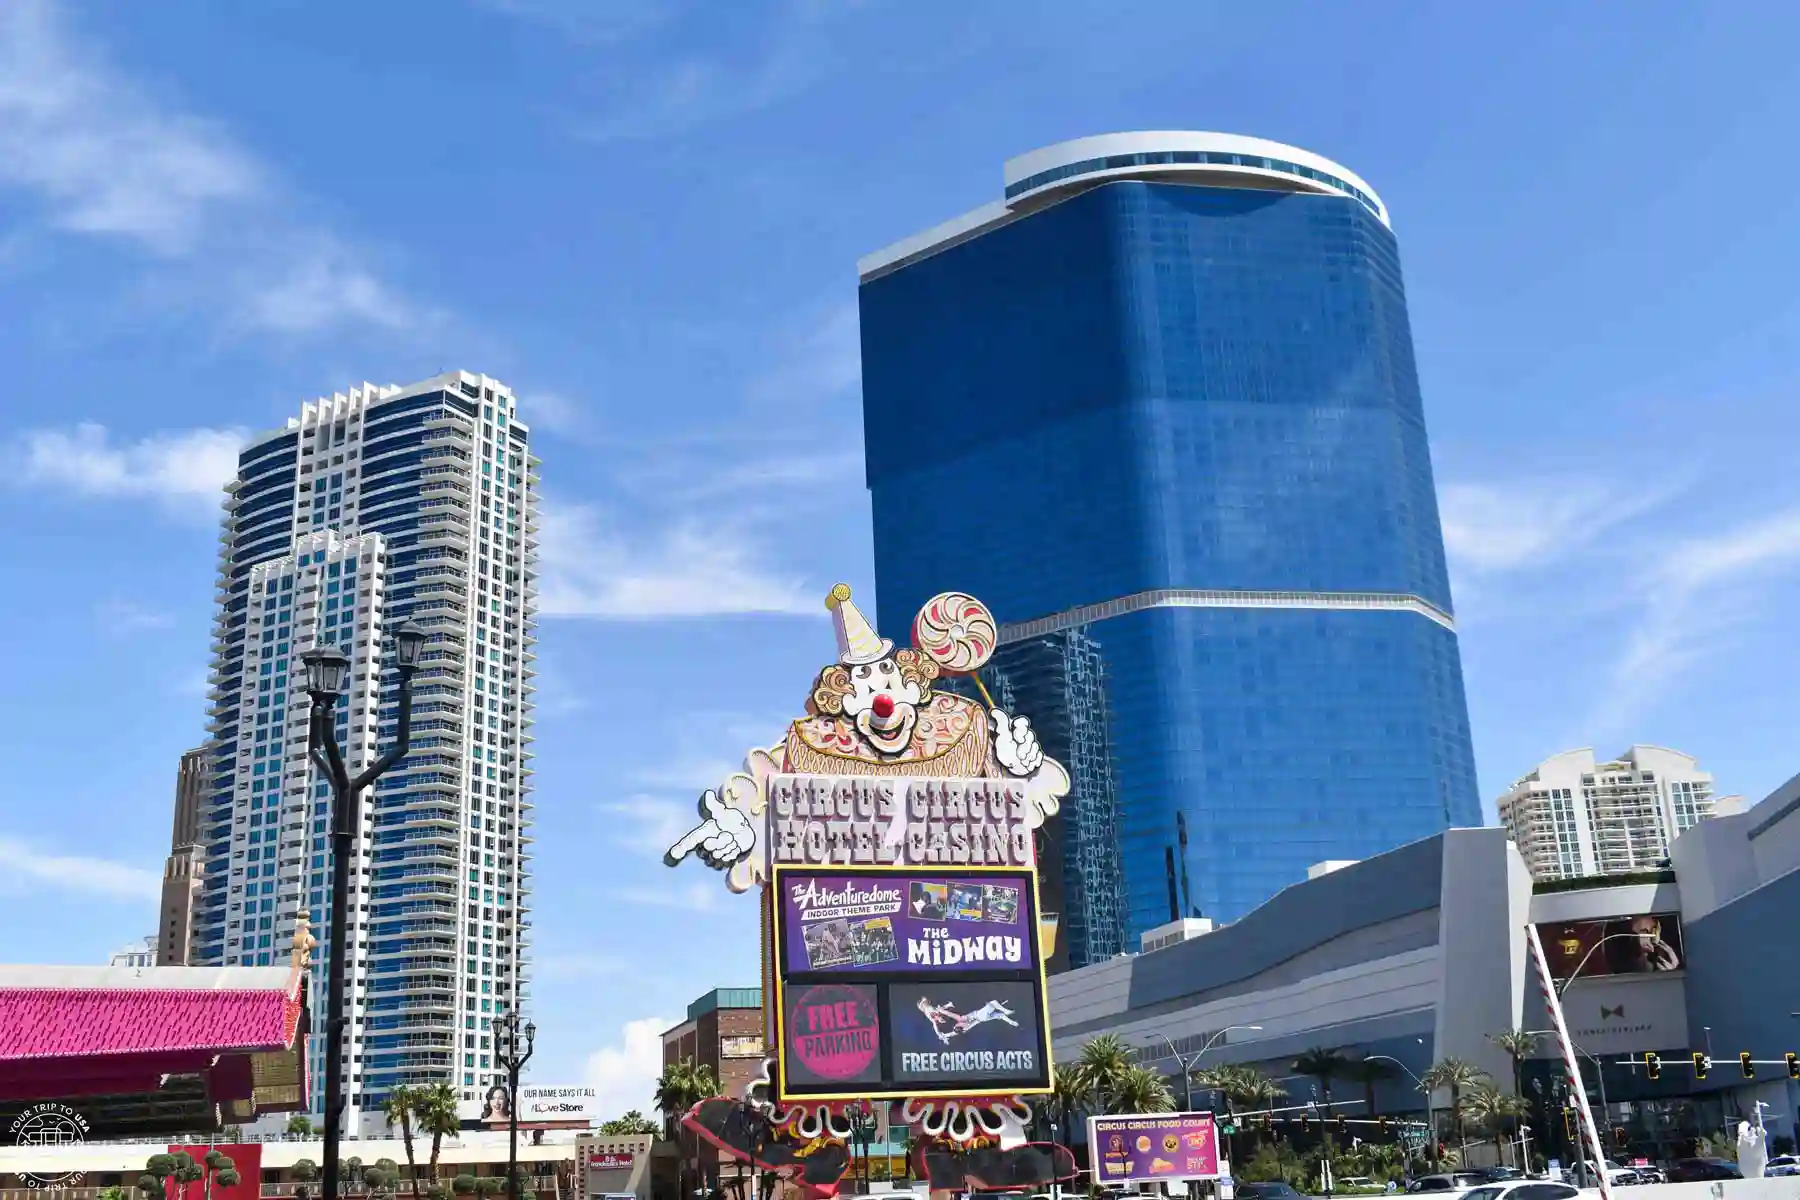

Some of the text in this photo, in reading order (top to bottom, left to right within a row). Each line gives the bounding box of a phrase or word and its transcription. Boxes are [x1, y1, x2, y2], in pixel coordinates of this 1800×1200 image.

[773, 777, 1026, 819] CIRCUS CIRCUS
[774, 821, 1030, 863] HOTEL CASINO
[791, 878, 902, 910] The Adventuredome
[807, 903, 896, 918] INDOOR THEME PARK
[807, 1001, 860, 1031] FREE
[805, 1031, 872, 1058] PARKING
[901, 1050, 1033, 1073] FREE CIRCUS ACTS
[524, 1088, 596, 1098] OUR NAME SAYS IT ALL
[559, 1103, 583, 1112] Store
[1097, 1122, 1126, 1131] CIRCUS
[1127, 1121, 1156, 1130] CIRCUS
[1157, 1120, 1181, 1128] FOOD
